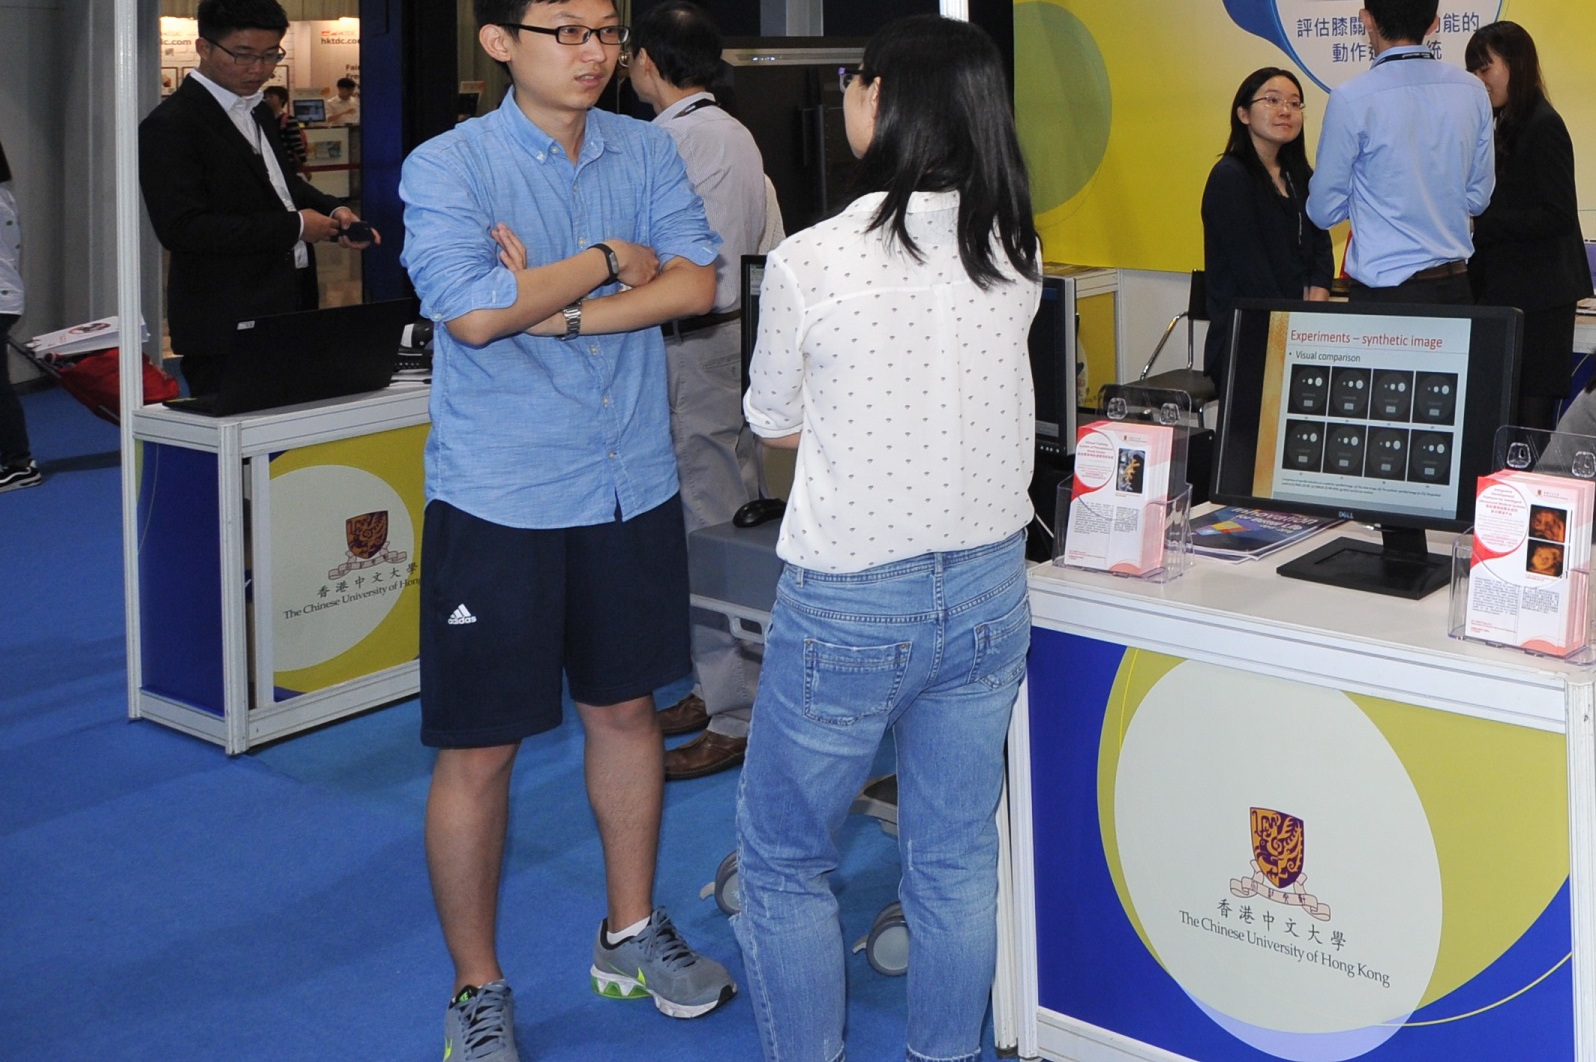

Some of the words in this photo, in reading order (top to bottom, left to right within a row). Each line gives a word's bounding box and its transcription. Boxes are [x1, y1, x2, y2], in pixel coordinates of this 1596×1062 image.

[1297, 12, 1480, 38] 評估膝關能的
[1291, 330, 1350, 343] Experiments
[1362, 334, 1408, 347] synthetic
[1411, 335, 1442, 350] image
[1296, 351, 1317, 360] Visual
[1318, 352, 1361, 363] comparison
[317, 562, 418, 598] 香港中文大學
[284, 609, 302, 619] The
[303, 599, 340, 614] Chinese
[342, 585, 387, 604] University
[388, 581, 398, 593] of
[448, 616, 477, 624] adidas
[1217, 898, 1347, 951] 香港中文大學
[1179, 910, 1200, 928] The
[1201, 918, 1245, 942] Chinese
[1247, 931, 1305, 962] University
[1306, 951, 1319, 964] of
[1321, 952, 1355, 978] Hong
[1357, 962, 1391, 989] Kong
